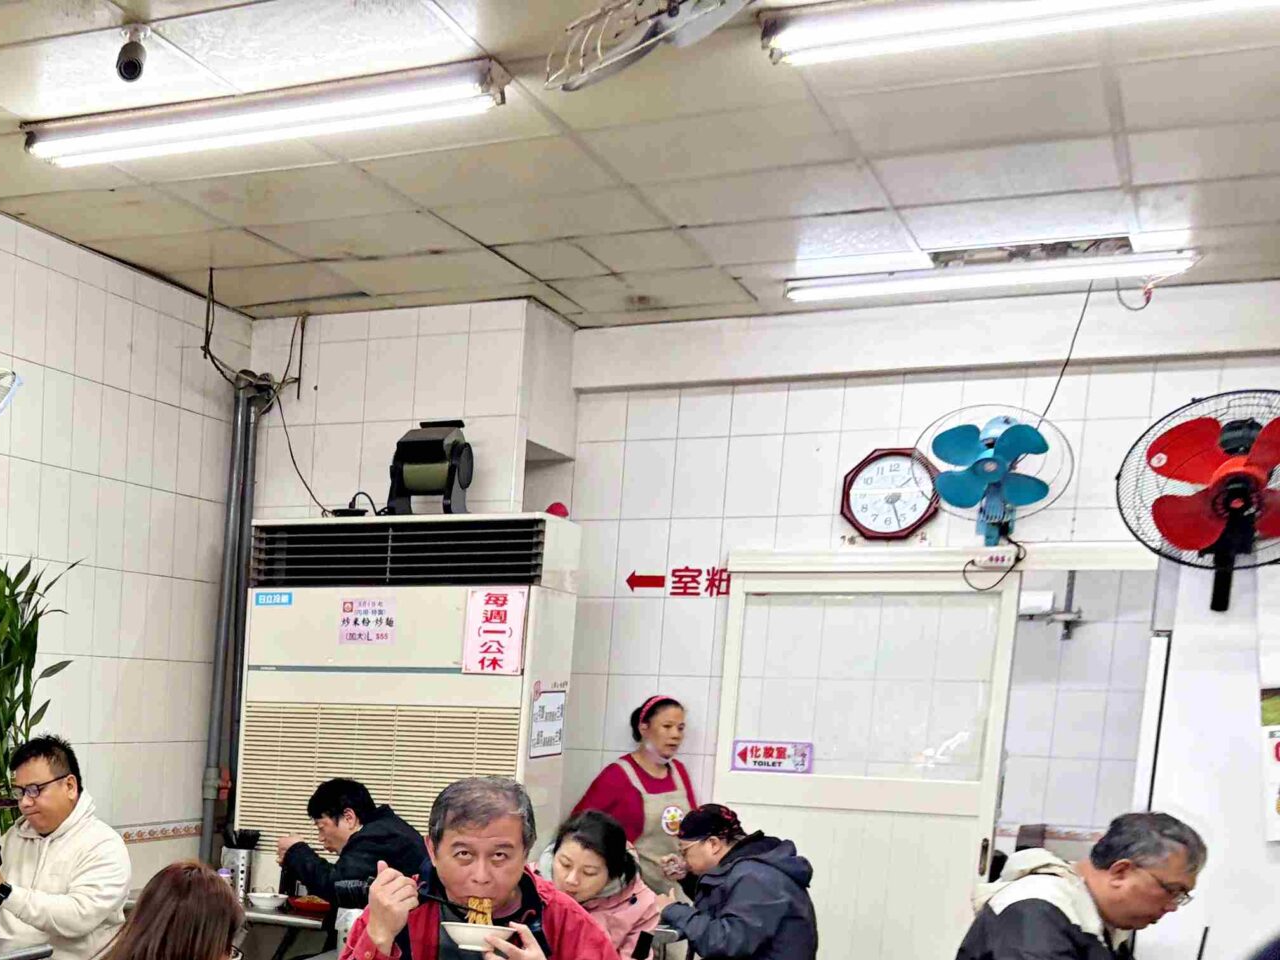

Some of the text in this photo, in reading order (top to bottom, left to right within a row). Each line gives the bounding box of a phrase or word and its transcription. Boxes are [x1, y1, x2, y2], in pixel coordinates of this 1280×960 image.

[876, 466, 884, 475] 11
[889, 463, 900, 472] 12
[863, 477, 873, 485] 10
[861, 504, 868, 512] 8
[910, 503, 917, 512] 4
[871, 513, 879, 522] 7
[884, 517, 892, 526] 6
[478, 592, 513, 671] 每週(一)公休
